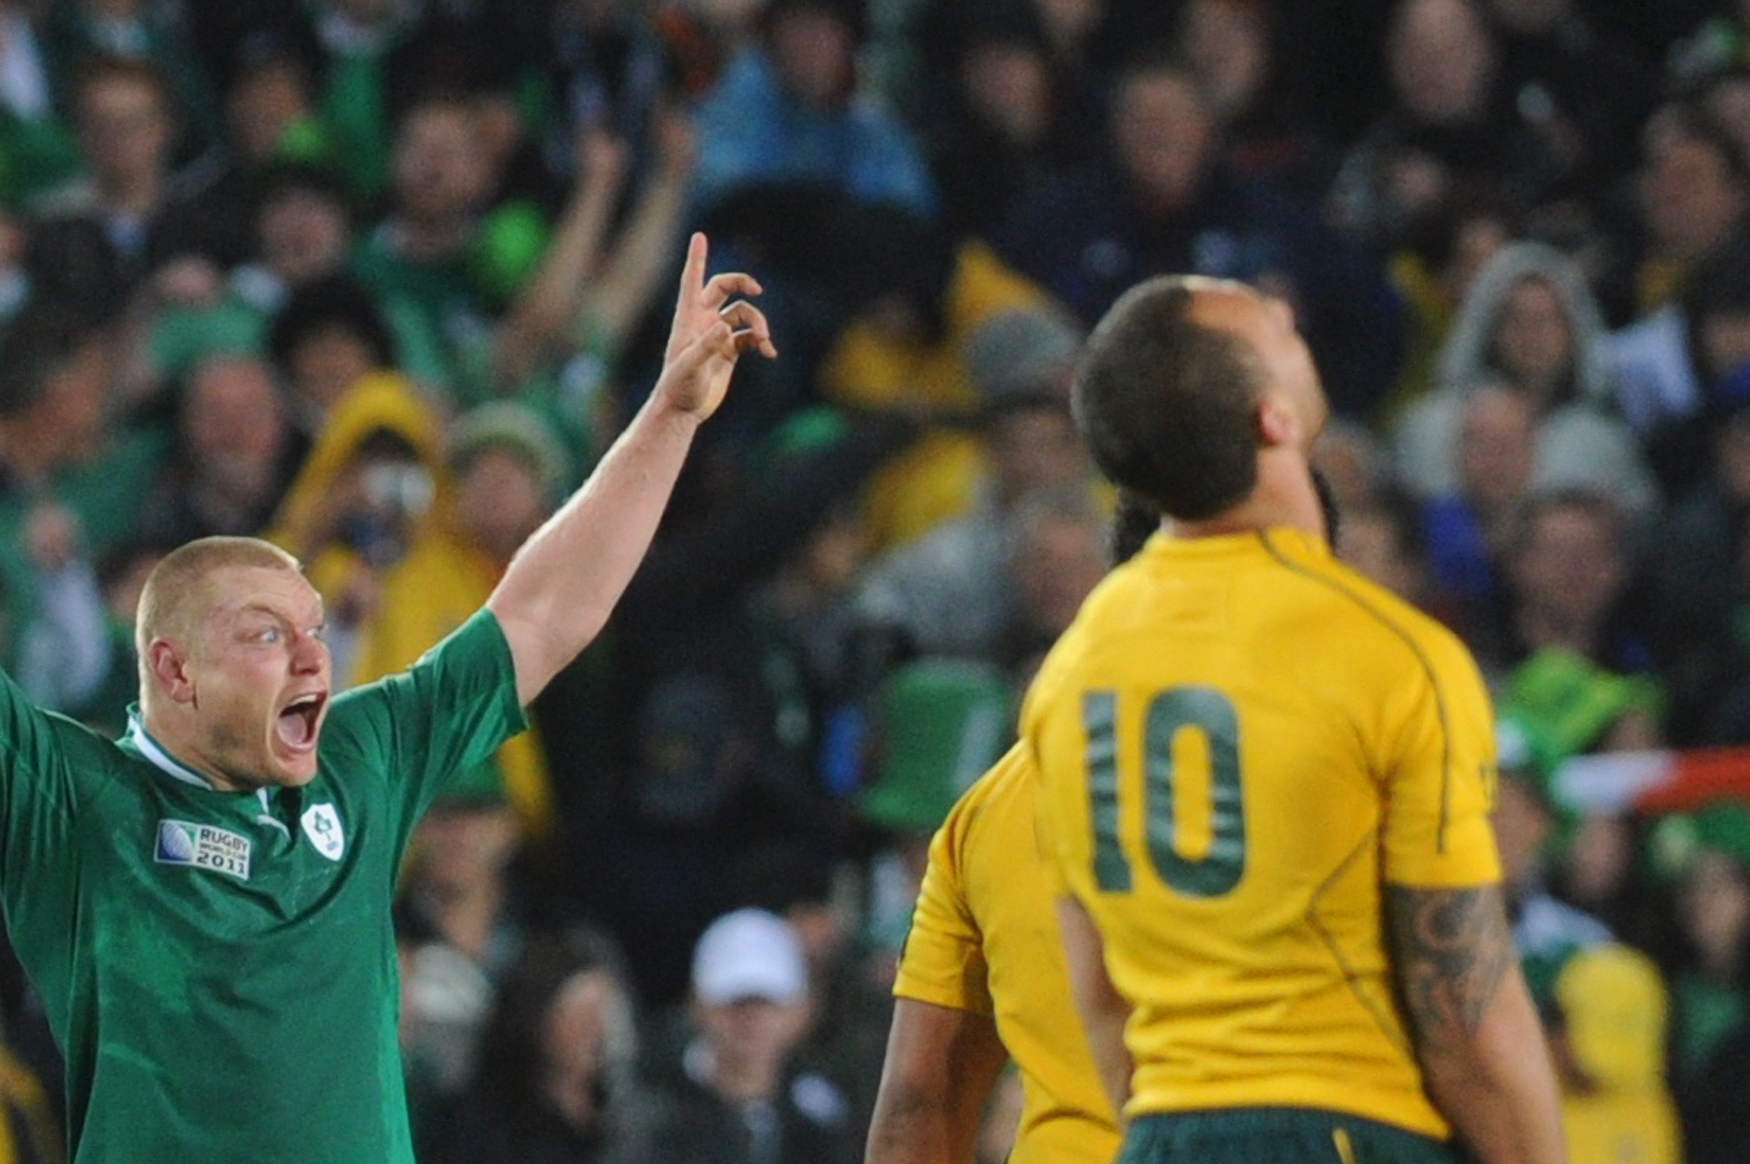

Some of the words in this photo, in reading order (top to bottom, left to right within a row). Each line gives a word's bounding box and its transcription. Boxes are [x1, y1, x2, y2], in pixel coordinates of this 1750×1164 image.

[1080, 683, 1246, 898] 10
[199, 843, 231, 857] WORLD
[200, 828, 248, 852] RUGBY
[196, 850, 245, 874] 2011
